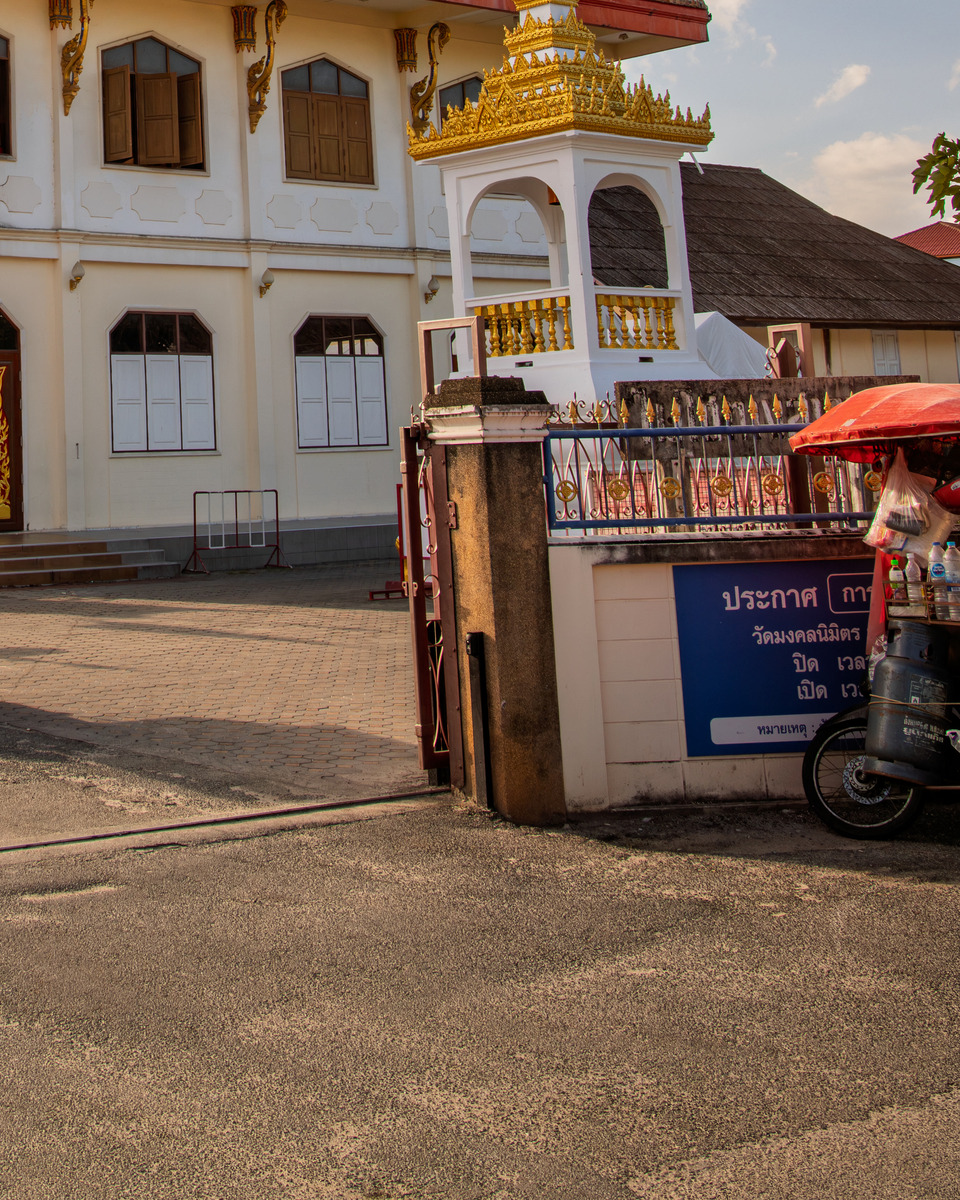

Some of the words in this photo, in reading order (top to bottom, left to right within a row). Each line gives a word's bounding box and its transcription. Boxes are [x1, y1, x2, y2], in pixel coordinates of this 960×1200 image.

[722, 585, 818, 611] ประกาศ
[752, 622, 861, 645] วัดมงคลนิมิตร
[792, 651, 819, 673] ปิด
[797, 679, 828, 700] เปิด
[757, 722, 808, 738] หมายเหตุ
